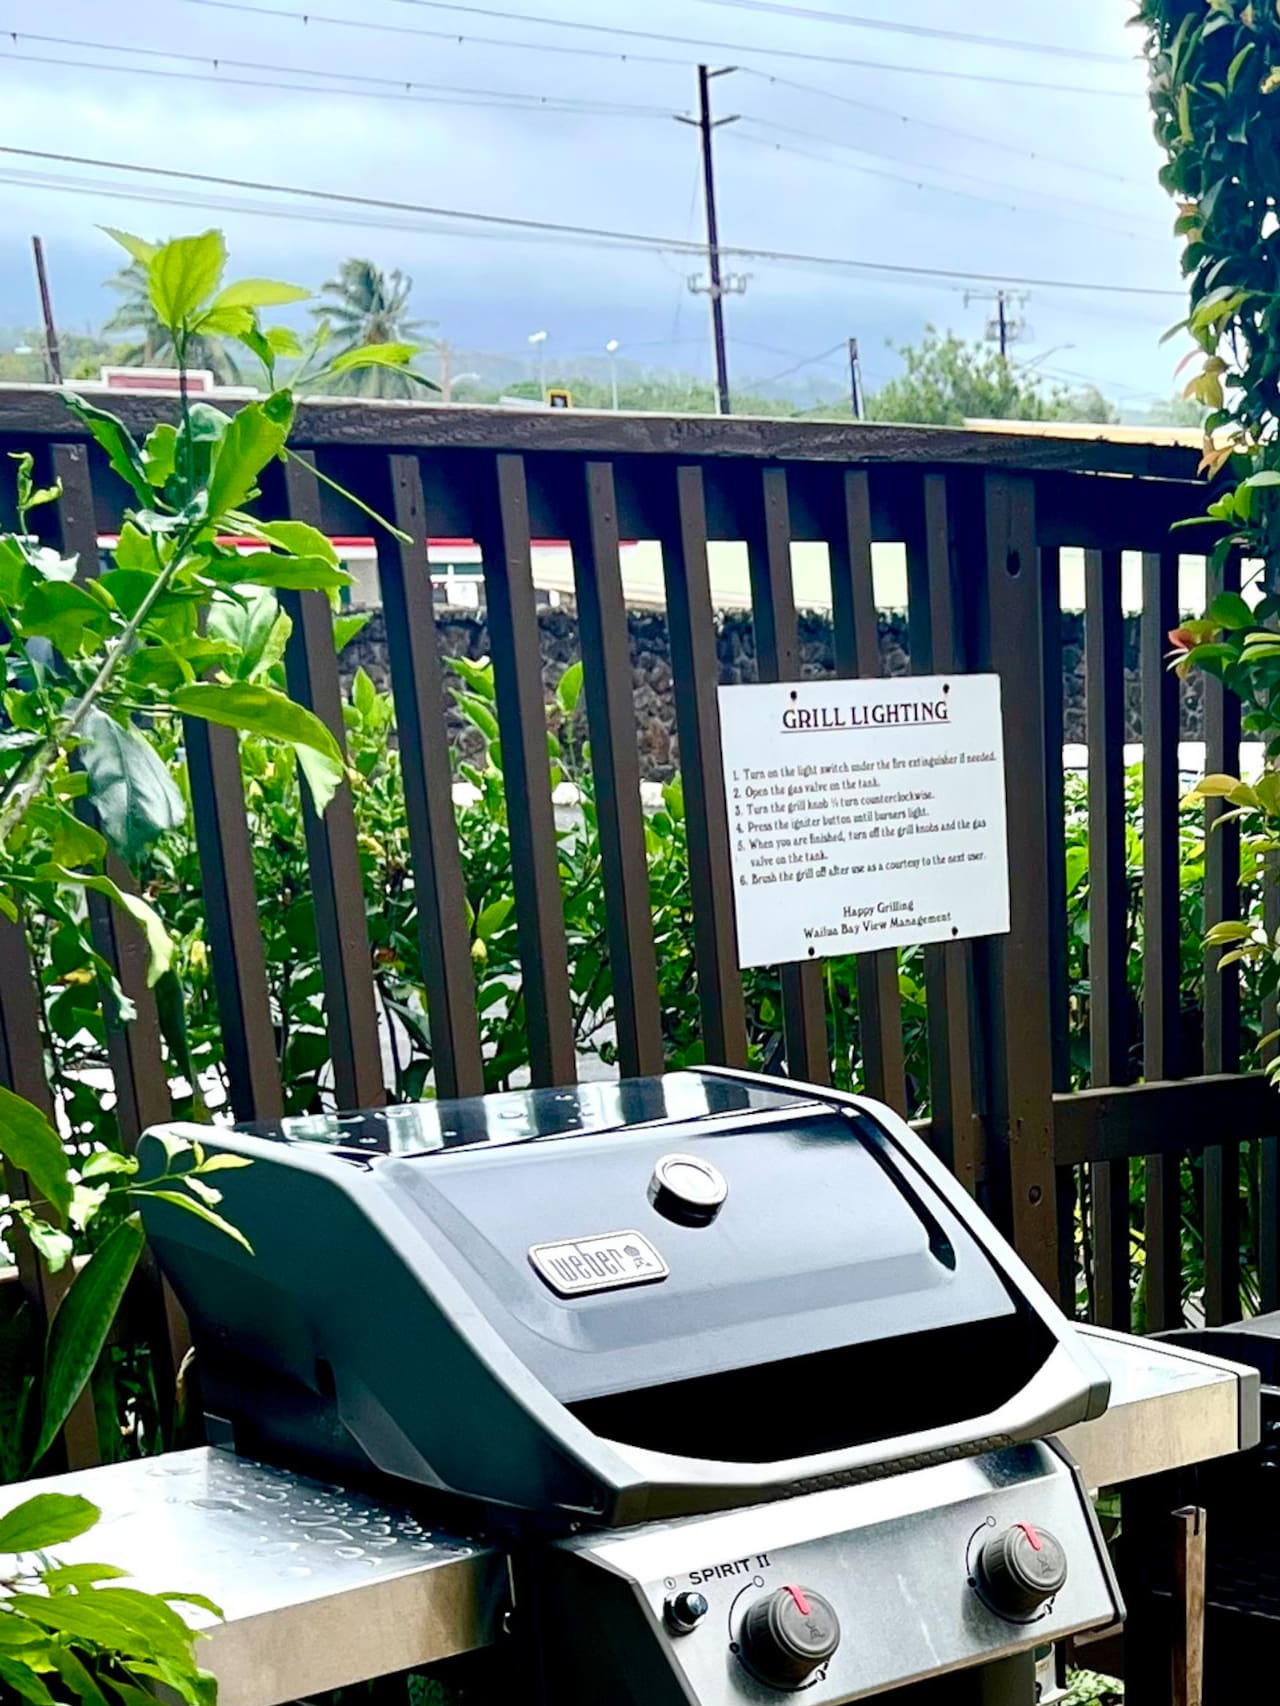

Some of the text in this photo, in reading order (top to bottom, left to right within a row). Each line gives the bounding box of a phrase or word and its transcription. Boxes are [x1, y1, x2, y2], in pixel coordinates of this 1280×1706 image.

[782, 701, 948, 729] GRILL LIGHTING
[733, 770, 740, 780] 1.
[743, 768, 766, 780] Turn
[767, 770, 778, 779] on
[780, 766, 795, 777] the
[797, 765, 817, 777] light
[820, 762, 849, 775] switch
[851, 760, 875, 772] under
[877, 760, 890, 770] the
[892, 758, 906, 769] fire
[908, 755, 958, 768] extinguisher
[959, 752, 965, 764] if
[733, 777, 880, 799] 2. Open the gas valve on the tank.
[735, 805, 743, 816] 3.
[747, 804, 768, 815] Turn
[770, 802, 785, 813] the
[787, 800, 806, 813] grill
[808, 798, 829, 810] knob
[840, 798, 859, 807] turn
[861, 791, 935, 805] counterclockwise.
[736, 807, 930, 833] 4. Press the igniter button until burners light.
[737, 819, 986, 851] 5. When you are finished, turn off the grill knobs and the gas
[740, 874, 748, 886] 6.
[752, 872, 777, 885] Brush
[779, 871, 793, 882] the
[796, 868, 814, 882] grill
[816, 866, 826, 877] off
[828, 865, 849, 876] after
[851, 865, 865, 874] use
[867, 864, 876, 873] as
[878, 863, 884, 871] a
[885, 859, 920, 870] courtesy
[922, 857, 931, 866] to
[932, 855, 947, 865] the
[948, 853, 965, 863] next
[750, 850, 829, 867] valve on the tank.
[843, 900, 914, 918] Happy Grilling
[803, 912, 951, 939] Wailua Bay View Management
[548, 1243, 626, 1282] weber
[689, 1554, 770, 1585] SPIRIT II
